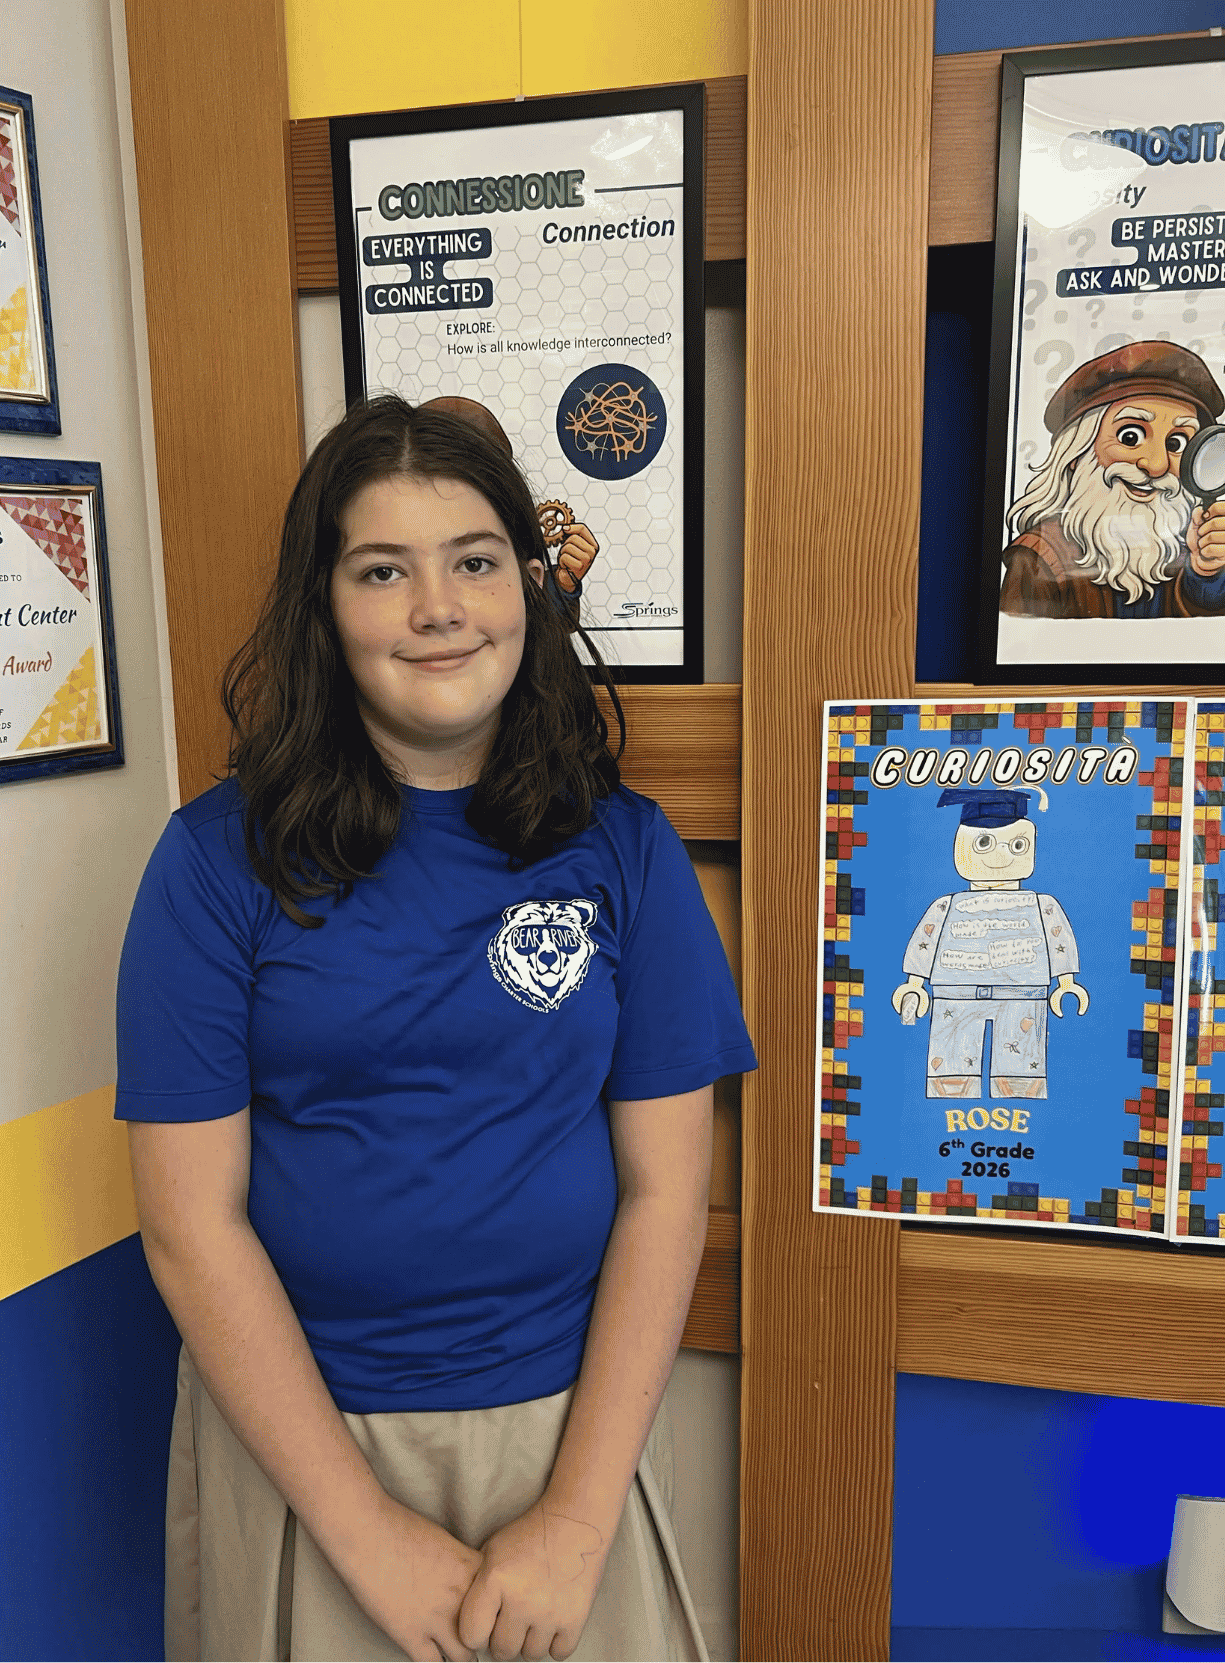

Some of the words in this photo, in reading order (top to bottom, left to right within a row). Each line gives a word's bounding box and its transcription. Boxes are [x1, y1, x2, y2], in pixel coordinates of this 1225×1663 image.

[378, 170, 584, 221] CONNESSIONE
[542, 216, 675, 244] Connection
[1121, 221, 1146, 240] BE
[1152, 215, 1225, 239] PERSIST
[371, 232, 482, 259] EVERYTHING
[1147, 240, 1225, 263] MASTER
[420, 261, 434, 280] IS
[1066, 271, 1102, 291] ASK
[1111, 267, 1150, 288] AND
[374, 283, 484, 307] CONNECTED
[446, 322, 496, 335] EXPLORE:
[447, 343, 474, 355] How
[477, 342, 487, 353] is
[490, 341, 503, 353] all
[507, 337, 571, 354] knowledge
[574, 332, 672, 348] interconnected?
[11, 574, 22, 582] TO
[18, 603, 77, 627] Center
[613, 602, 679, 618] Springs
[3, 651, 52, 676] Award
[513, 927, 541, 949] BEAR
[550, 928, 581, 948] RIVER
[522, 999, 549, 1014] SCHOOLS
[945, 1106, 1031, 1133] ROSE
[939, 1138, 965, 1157] 6th
[970, 1141, 1035, 1160] Grade
[961, 1161, 1010, 1178] 2026
